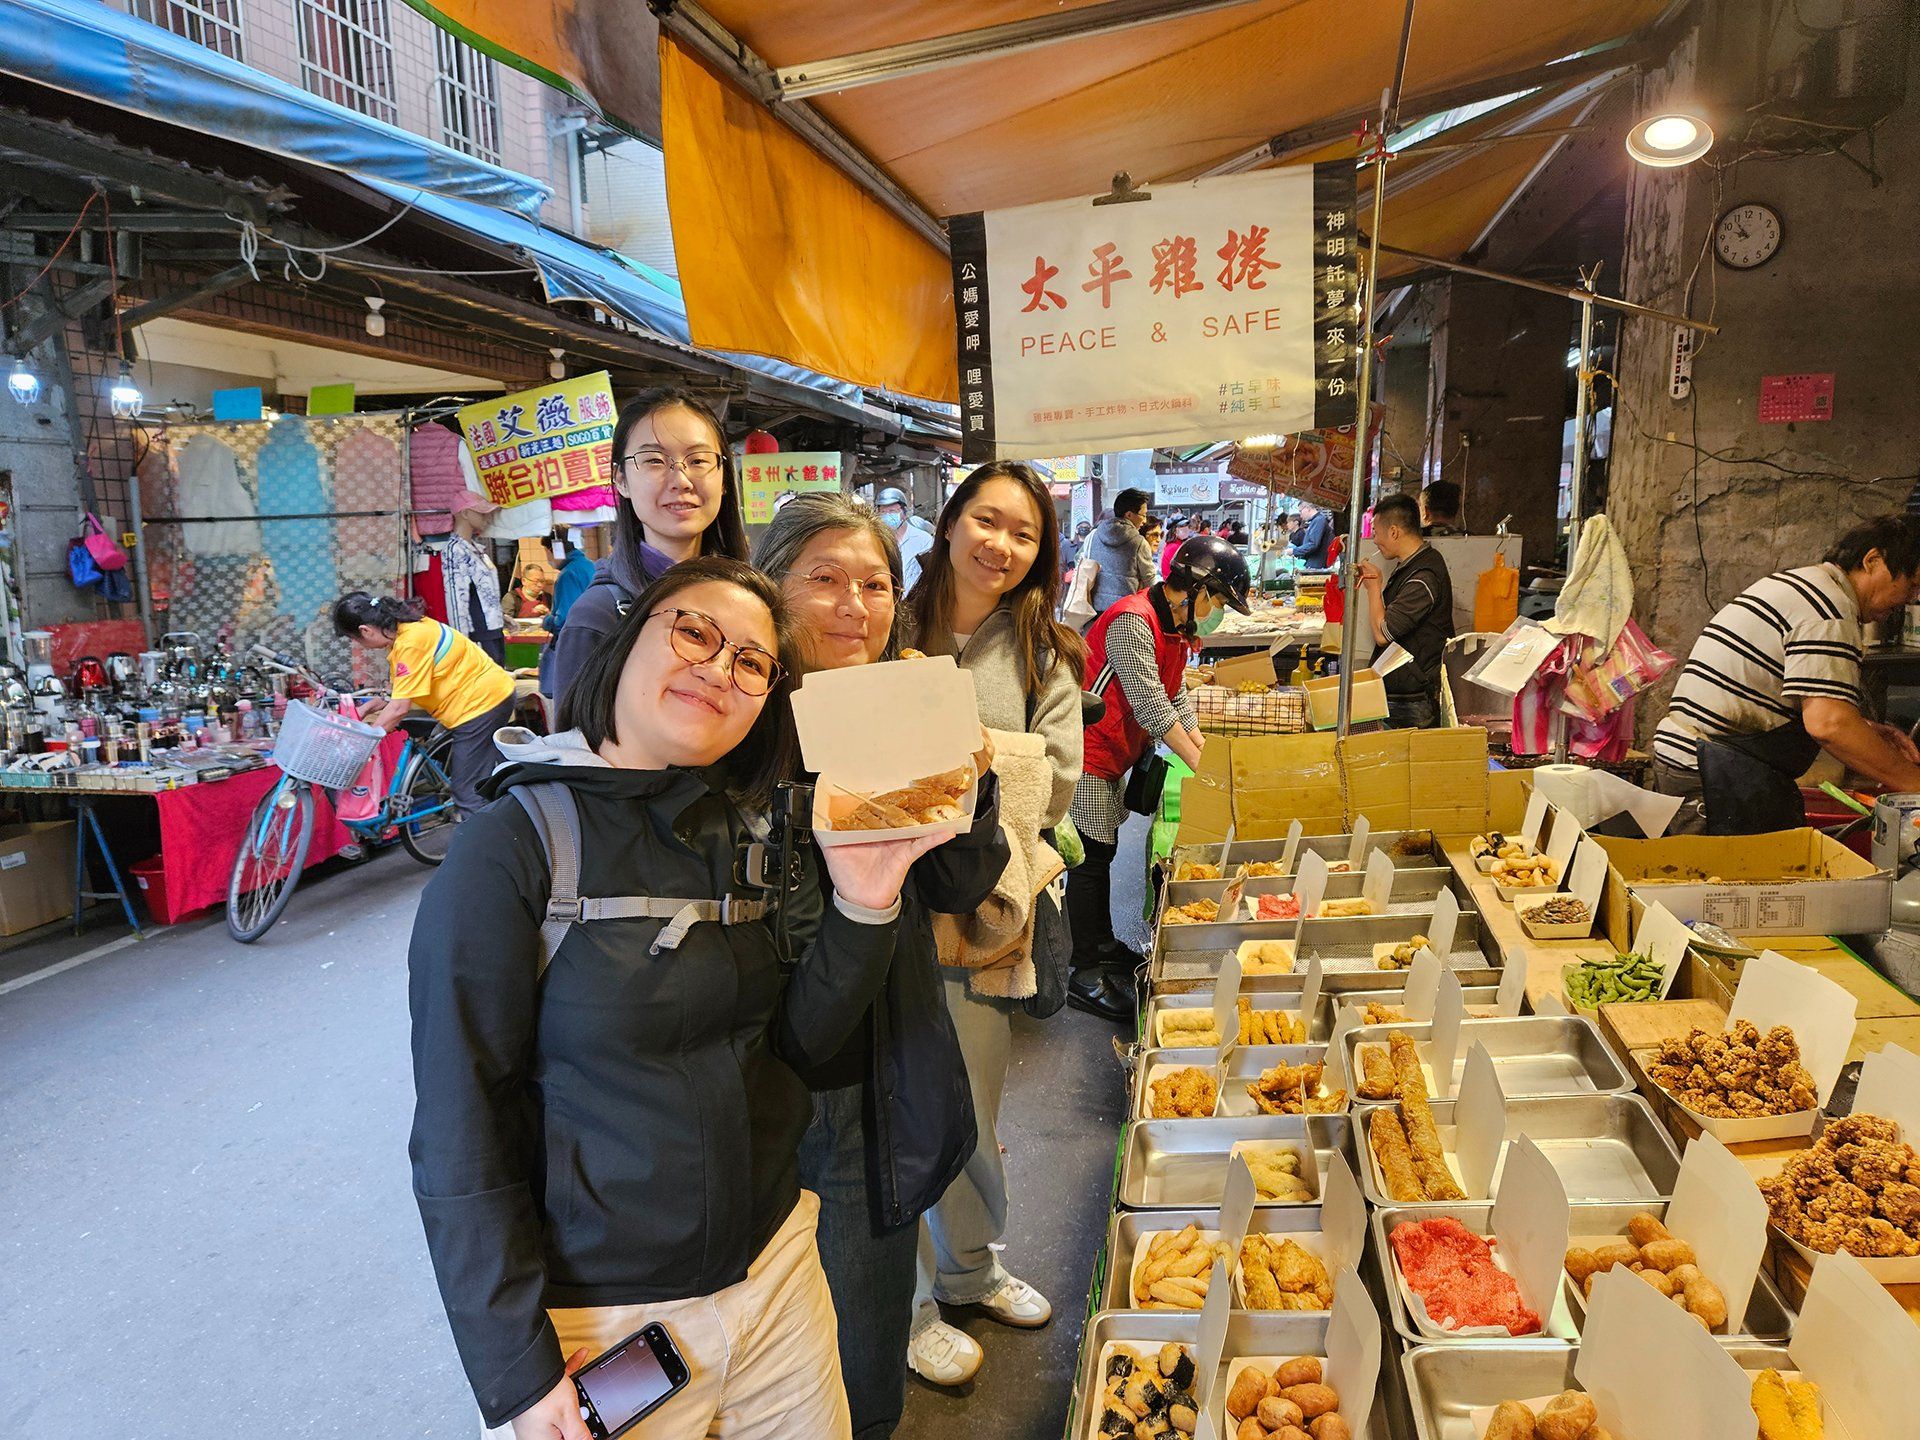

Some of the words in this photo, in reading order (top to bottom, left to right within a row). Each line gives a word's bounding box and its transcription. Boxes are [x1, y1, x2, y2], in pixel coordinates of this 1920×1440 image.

[1021, 225, 1281, 312] 太平雞捲
[1326, 211, 1345, 309] 神明託夢
[962, 263, 980, 350] 公媽愛呷
[1021, 326, 1117, 357] PEACE
[1150, 322, 1167, 343] &
[1202, 308, 1281, 338] SAFE
[1219, 377, 1281, 396] #古早味
[1326, 327, 1345, 396] 來一份
[967, 368, 984, 432] 哩愛買
[1219, 396, 1281, 414] #純手工
[520, 436, 565, 458] 新光三越
